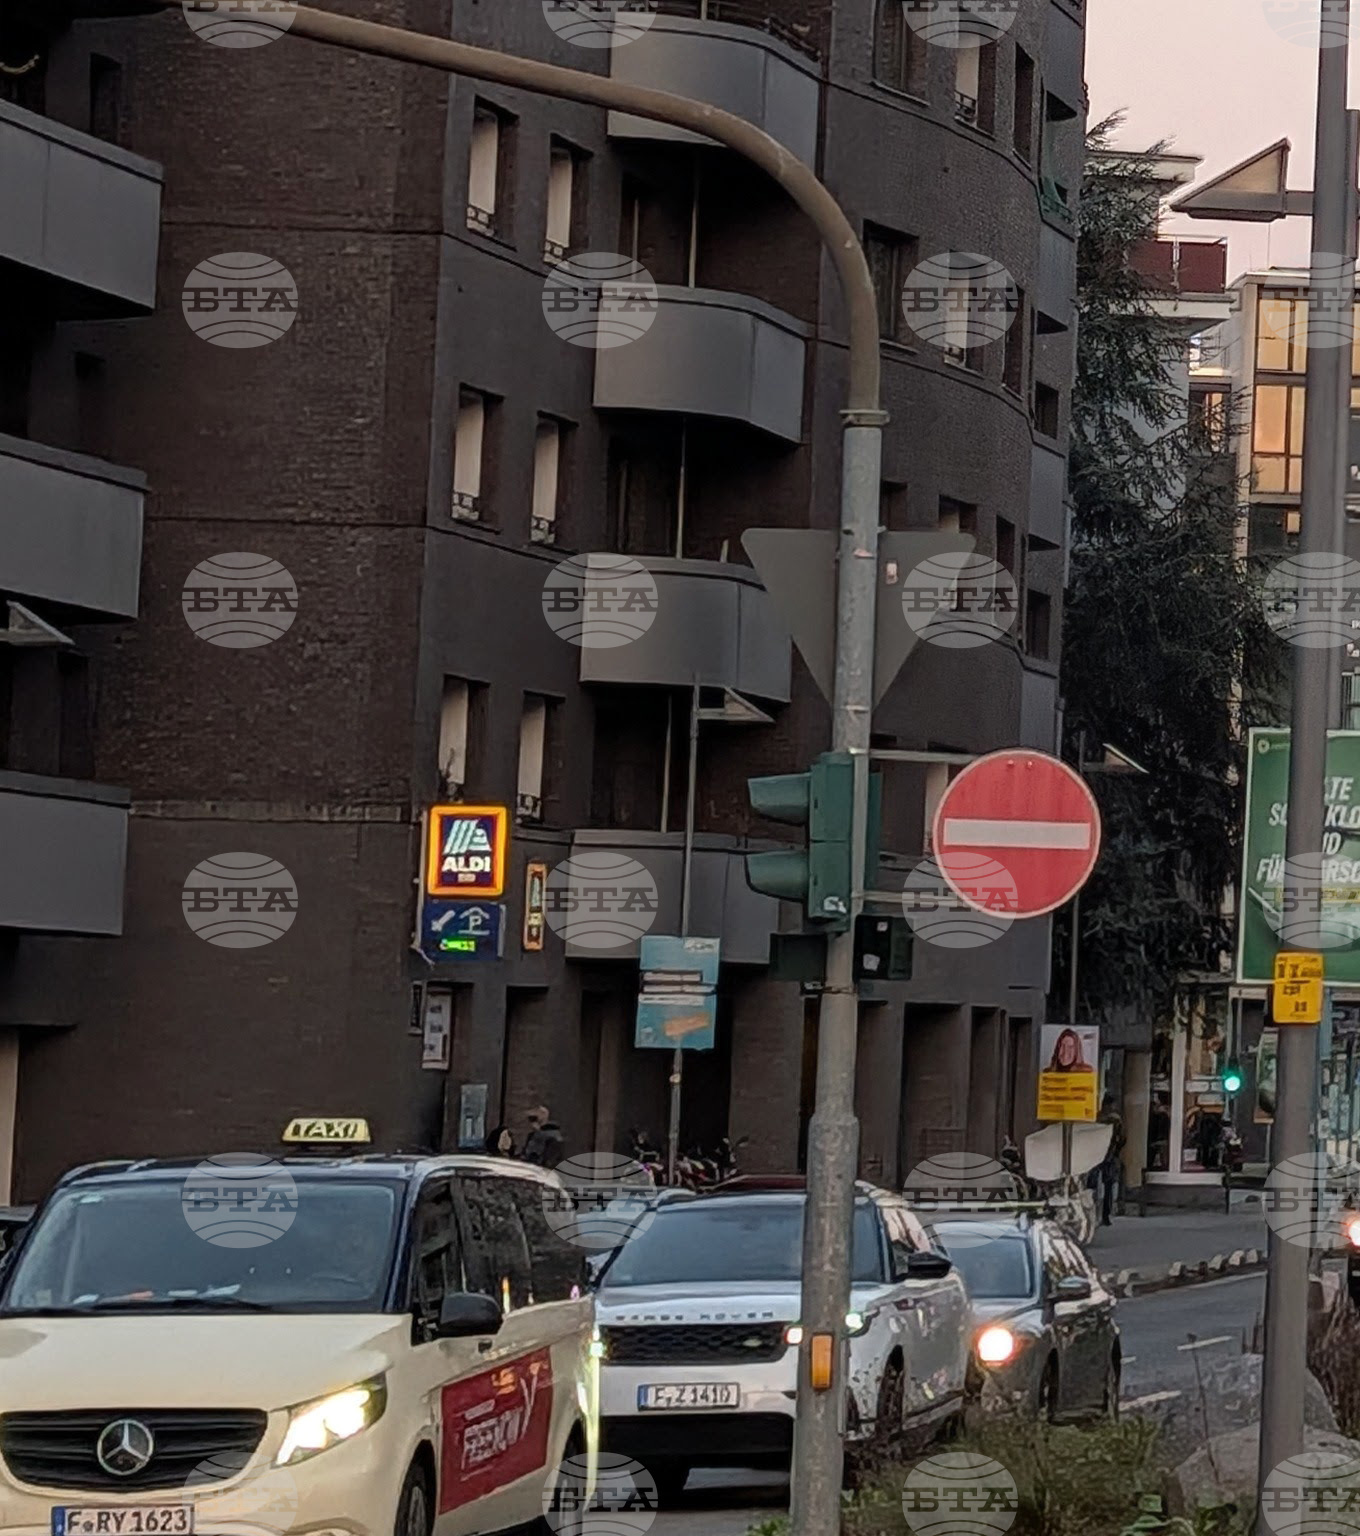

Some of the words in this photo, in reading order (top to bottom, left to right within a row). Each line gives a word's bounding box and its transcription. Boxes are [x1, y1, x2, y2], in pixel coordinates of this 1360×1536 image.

[441, 855, 491, 873] ALDI
[291, 1121, 359, 1139] TAXI
[129, 1509, 188, 1533] 1623
